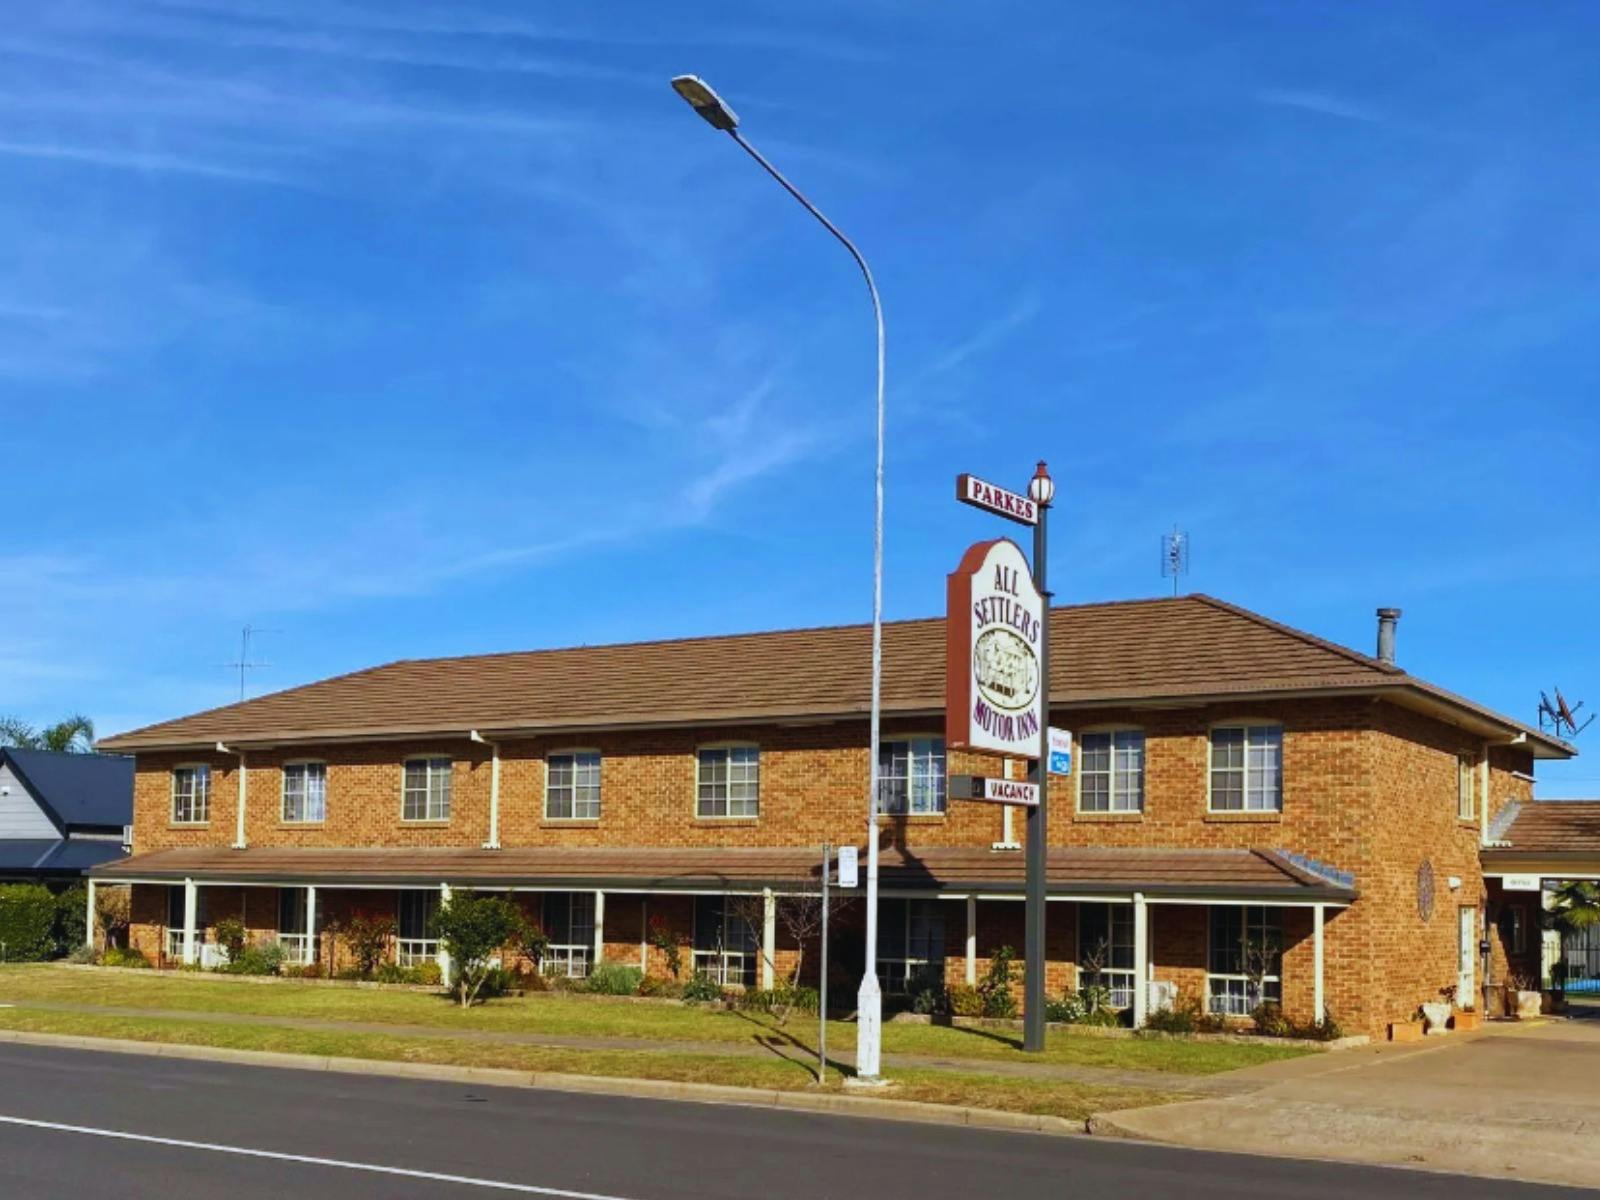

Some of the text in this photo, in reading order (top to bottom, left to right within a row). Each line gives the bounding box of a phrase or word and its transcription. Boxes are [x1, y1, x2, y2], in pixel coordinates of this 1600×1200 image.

[973, 481, 1033, 519] PARKES
[994, 563, 1019, 597] ALL
[974, 596, 1039, 644] SETTLERS
[974, 696, 1038, 742] MOTOR INN
[990, 782, 1034, 801] VACANCY
